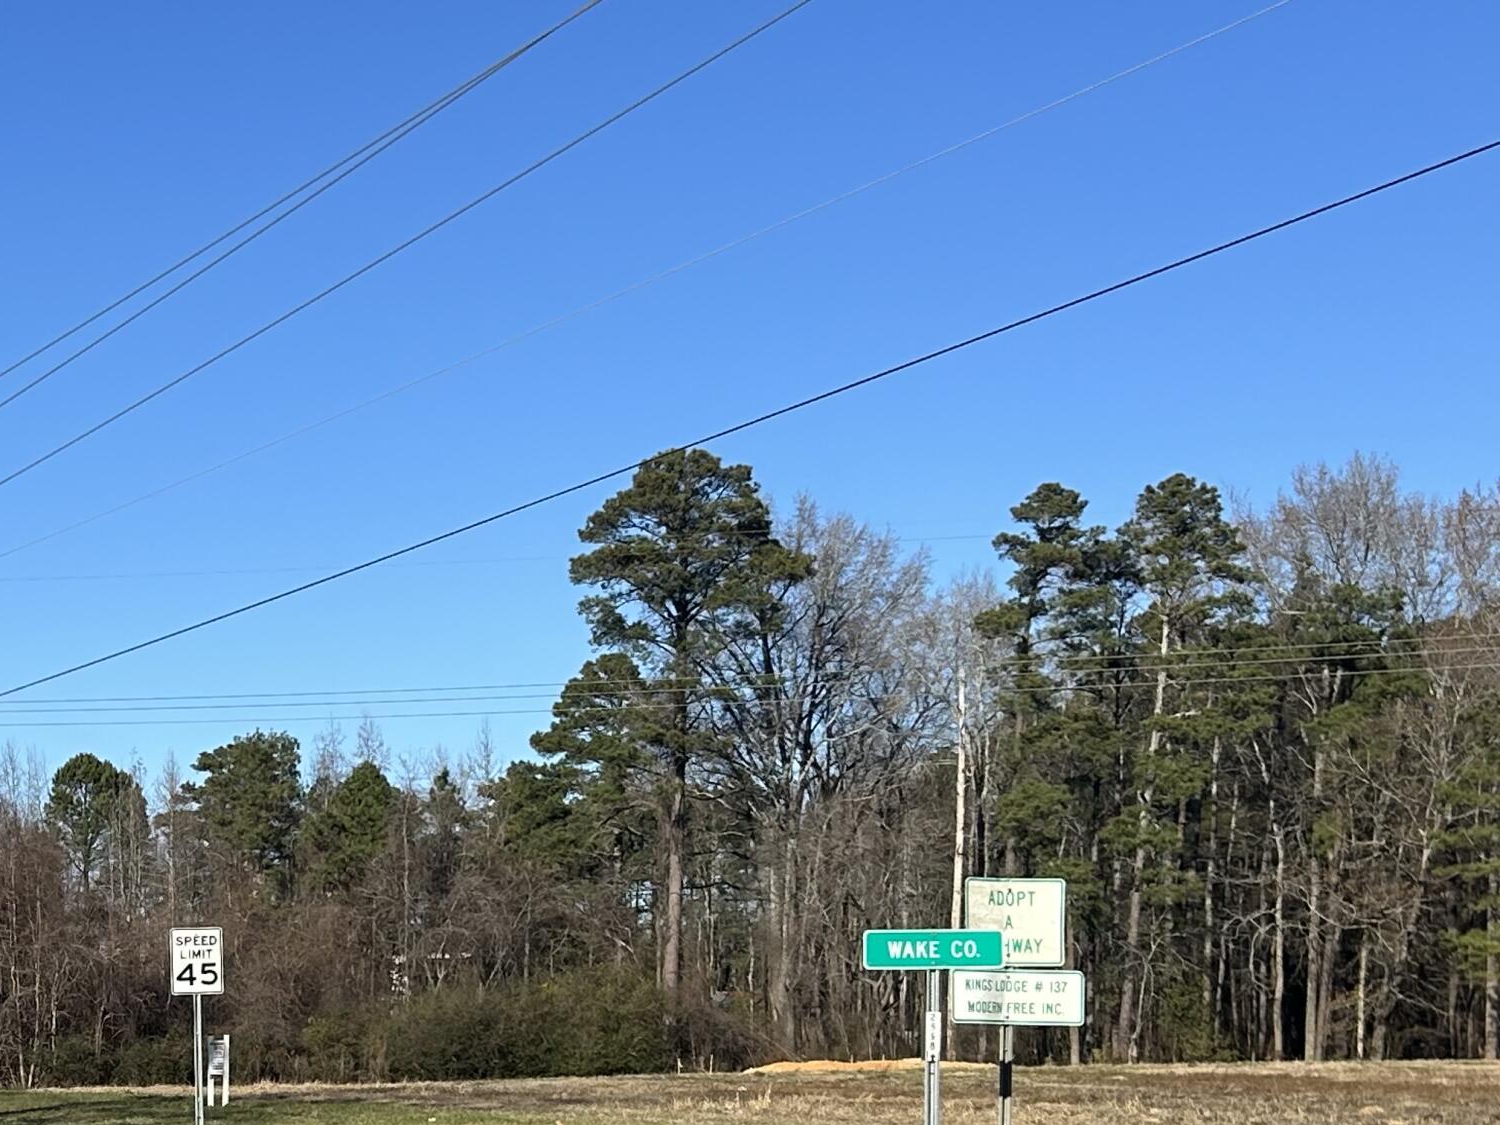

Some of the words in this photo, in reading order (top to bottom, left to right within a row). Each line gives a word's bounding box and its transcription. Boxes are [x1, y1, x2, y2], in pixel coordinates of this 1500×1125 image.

[988, 890, 1036, 906] ADOPT
[1005, 915, 1013, 929] A
[176, 935, 217, 946] SPEED
[180, 949, 212, 959] LIMIT
[887, 940, 941, 959] WAKE
[950, 940, 980, 958] CO.
[176, 962, 218, 986] 45
[965, 979, 993, 992] KINGS
[995, 980, 1028, 993] LODGE
[1035, 982, 1043, 992] #
[1050, 981, 1067, 993] 137
[967, 1000, 1003, 1013] MODERN
[1006, 1002, 1036, 1015] FREE
